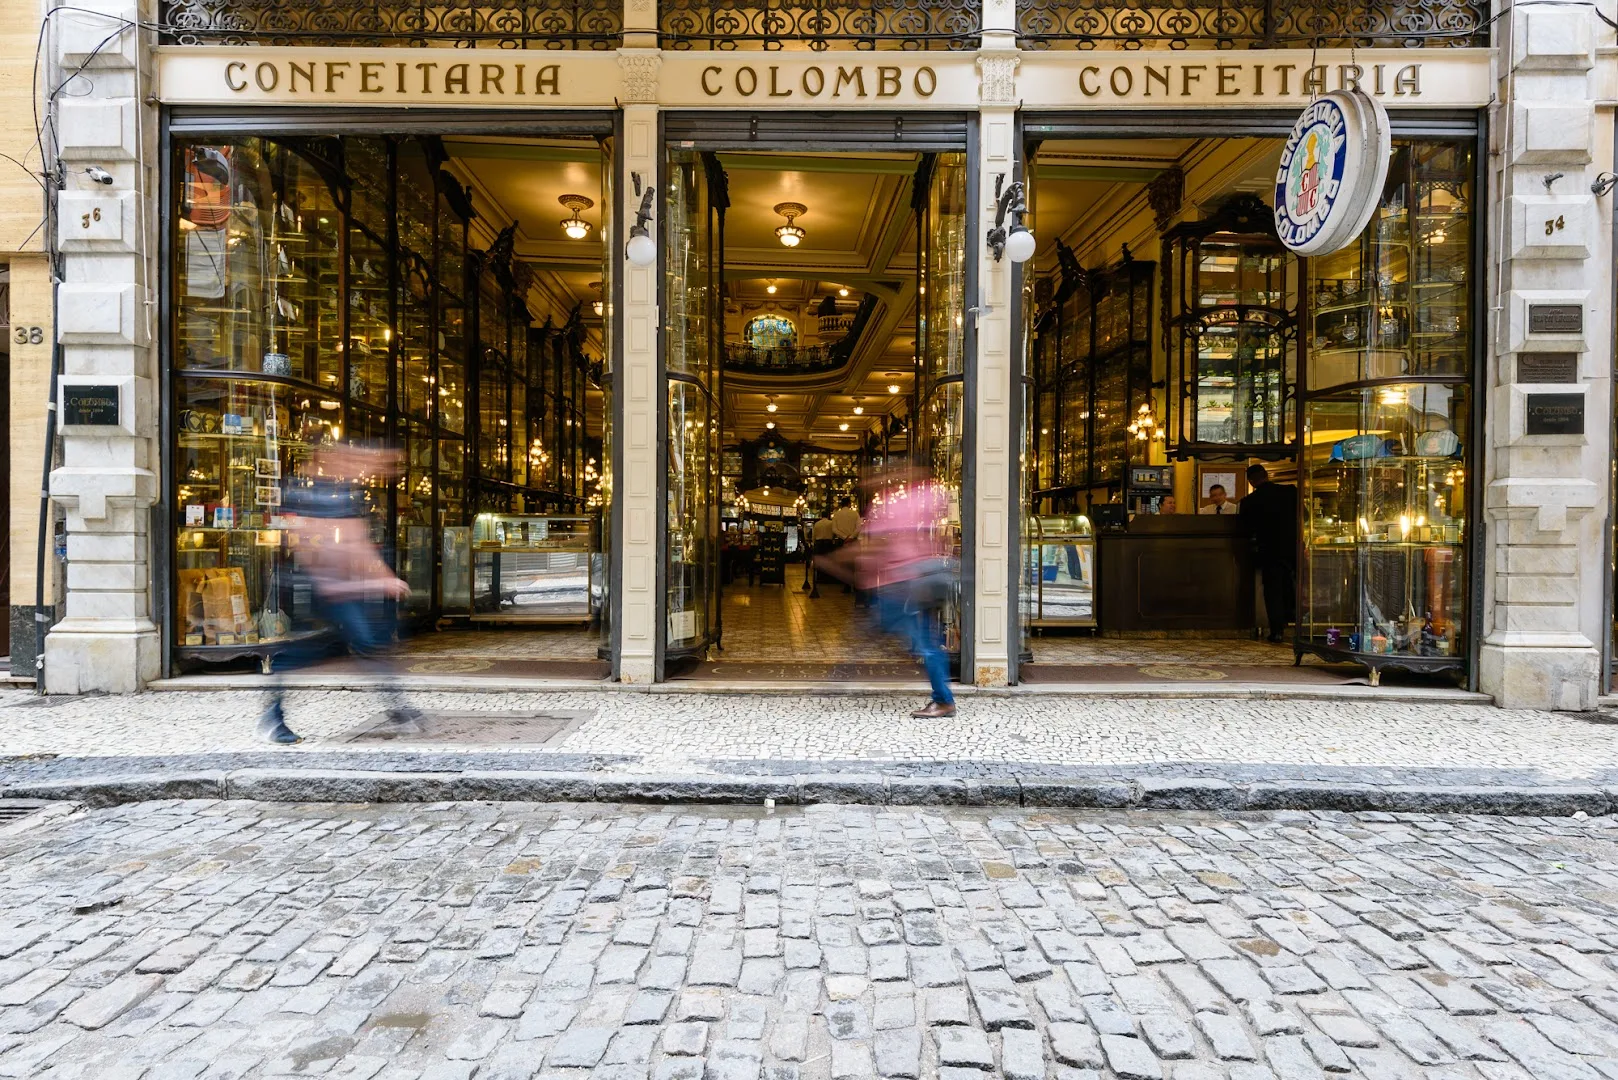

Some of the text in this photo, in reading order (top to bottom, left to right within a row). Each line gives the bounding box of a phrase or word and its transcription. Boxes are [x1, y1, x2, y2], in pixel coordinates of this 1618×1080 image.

[224, 61, 561, 95] CONFEITARIA
[701, 66, 937, 97] COLOMBO
[1079, 64, 1422, 96] CONFEITARIA
[1277, 103, 1345, 184] CONFEITARIA
[82, 207, 101, 229] 36
[1275, 179, 1340, 243] COLOMBO
[1545, 214, 1565, 236] 34
[14, 326, 44, 345] 38
